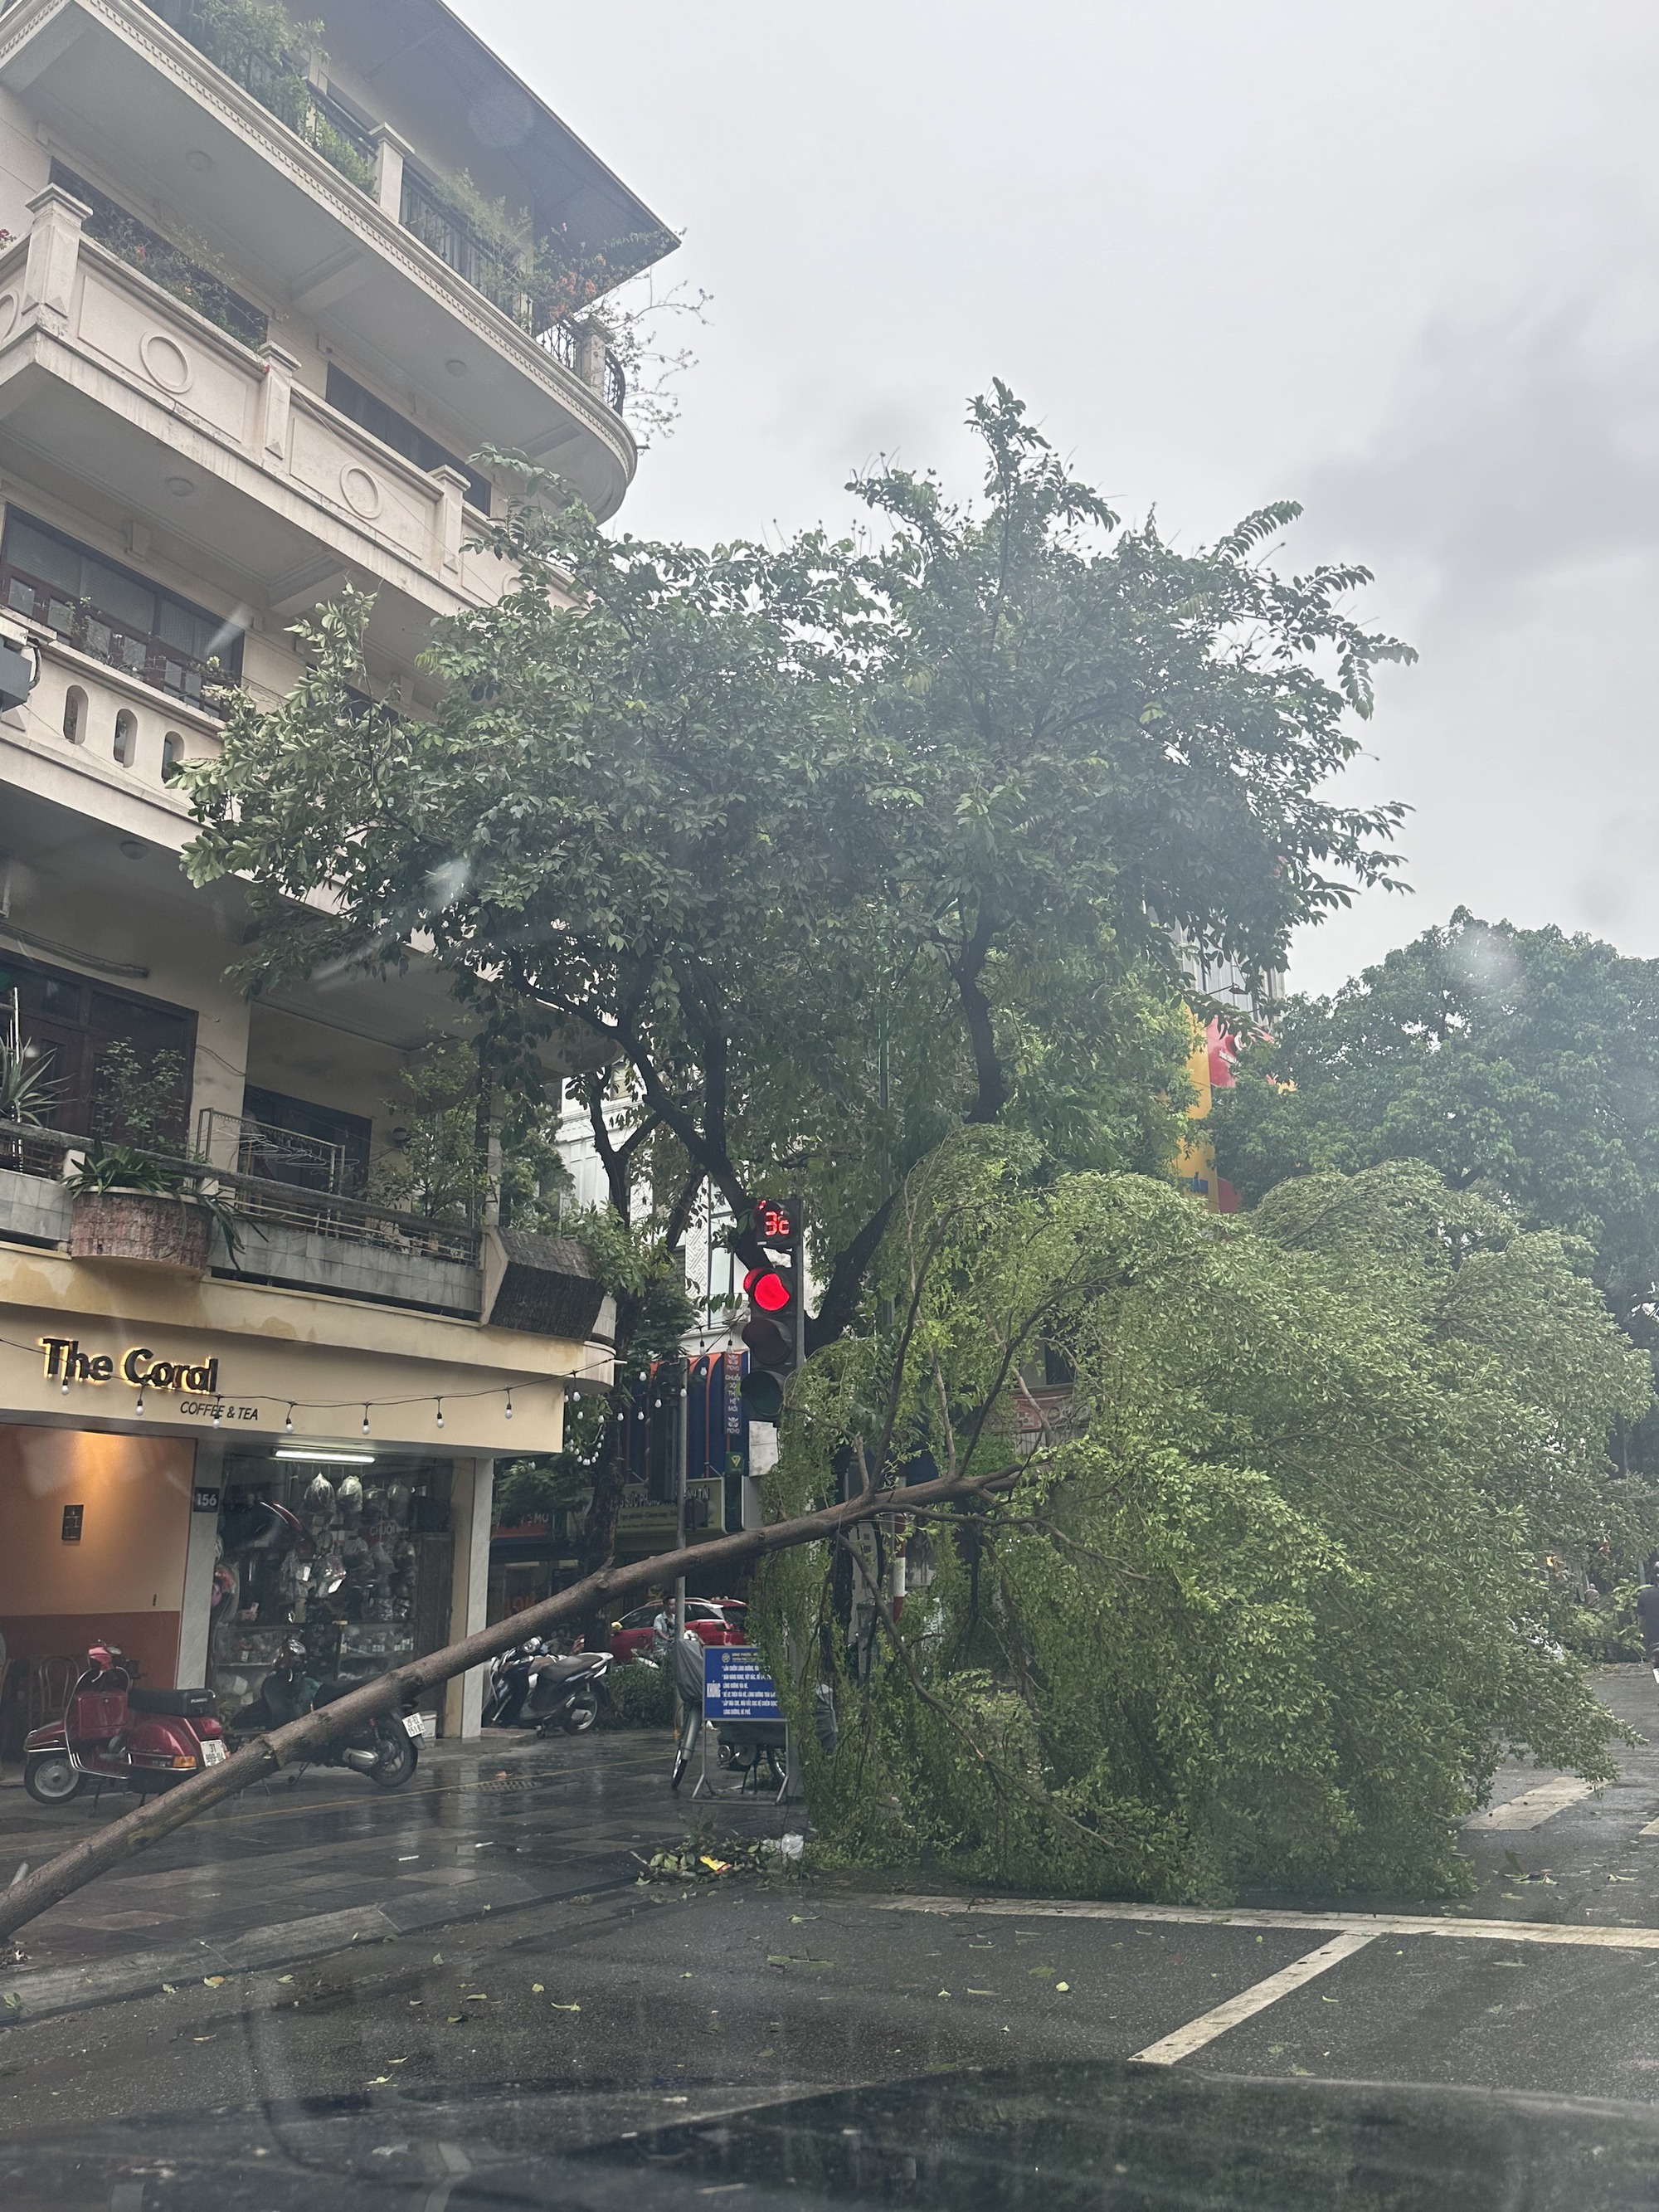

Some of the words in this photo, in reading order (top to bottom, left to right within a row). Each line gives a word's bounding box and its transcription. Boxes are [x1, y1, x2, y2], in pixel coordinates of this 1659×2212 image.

[42, 1337, 114, 1381] The
[124, 1347, 219, 1393] Coral
[180, 1401, 225, 1418] COFFEE
[226, 1406, 236, 1419] &
[238, 1407, 259, 1421] TEA
[197, 1493, 217, 1507] 156
[209, 1743, 216, 1753] 31
